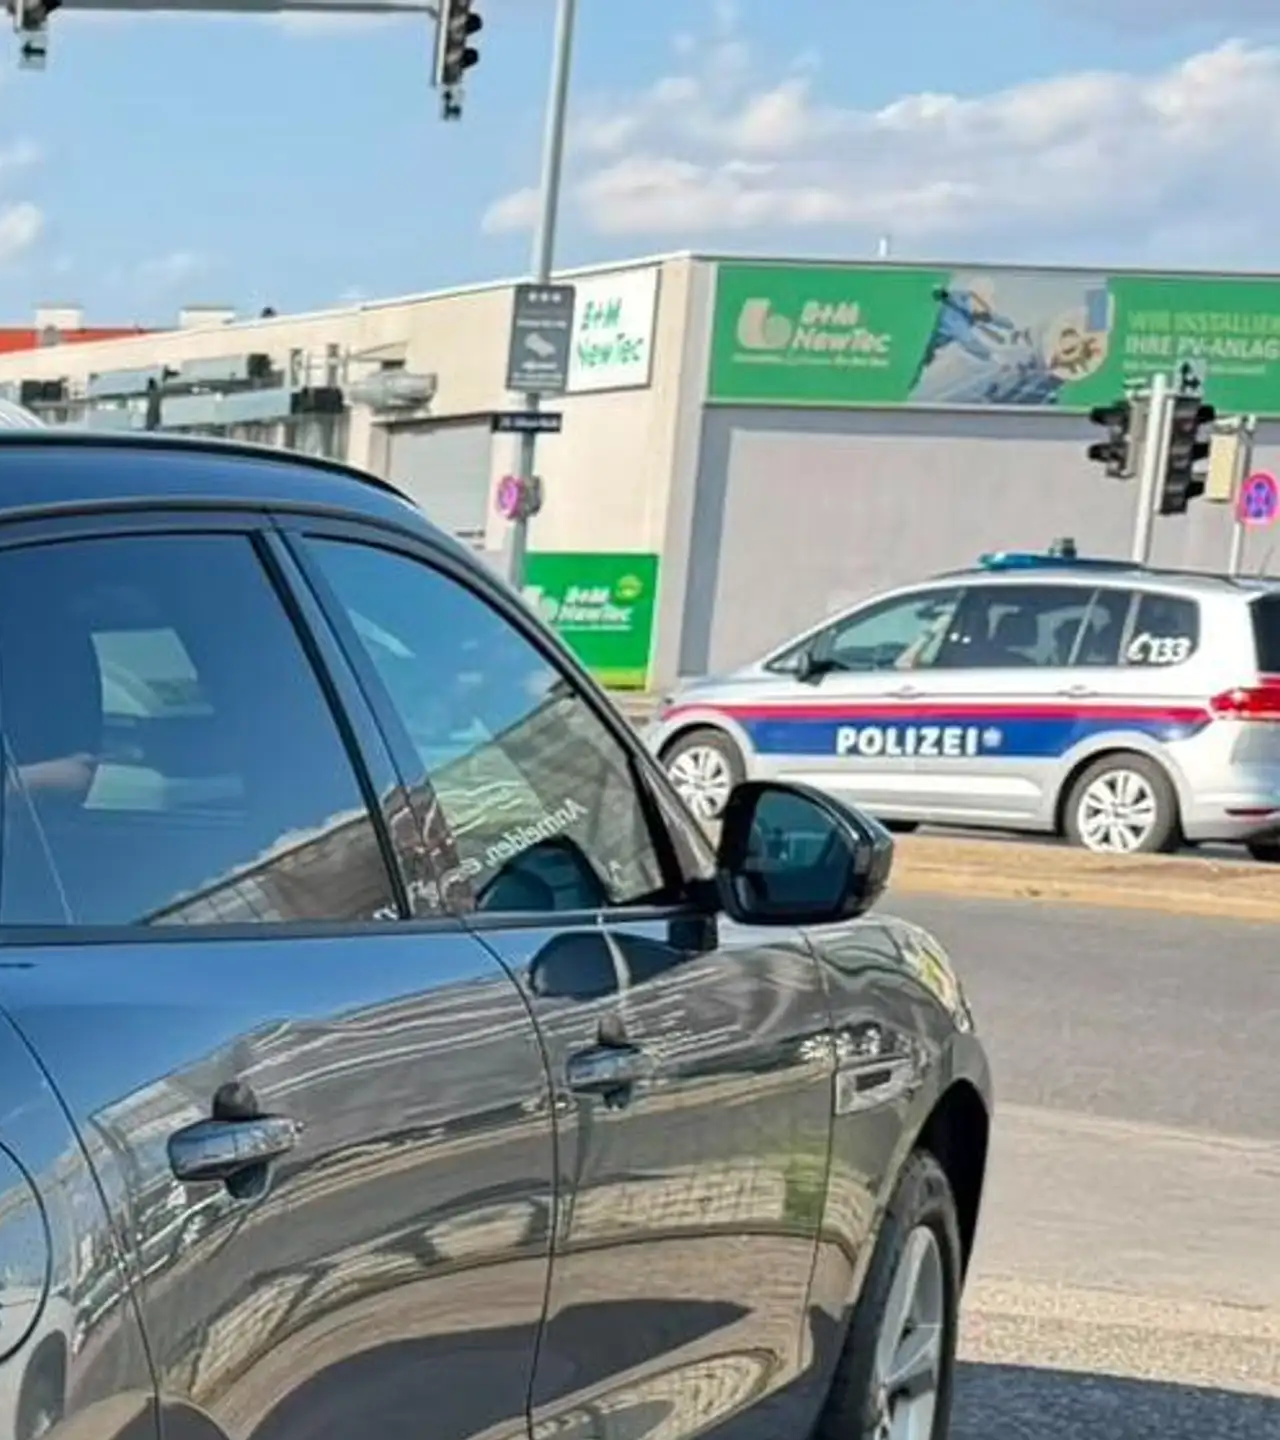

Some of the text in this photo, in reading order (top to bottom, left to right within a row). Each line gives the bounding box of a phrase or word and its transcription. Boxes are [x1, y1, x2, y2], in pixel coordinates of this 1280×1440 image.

[1126, 334, 1172, 355] IHRE
[1147, 635, 1190, 662] 133
[836, 726, 977, 755] POLIZEI
